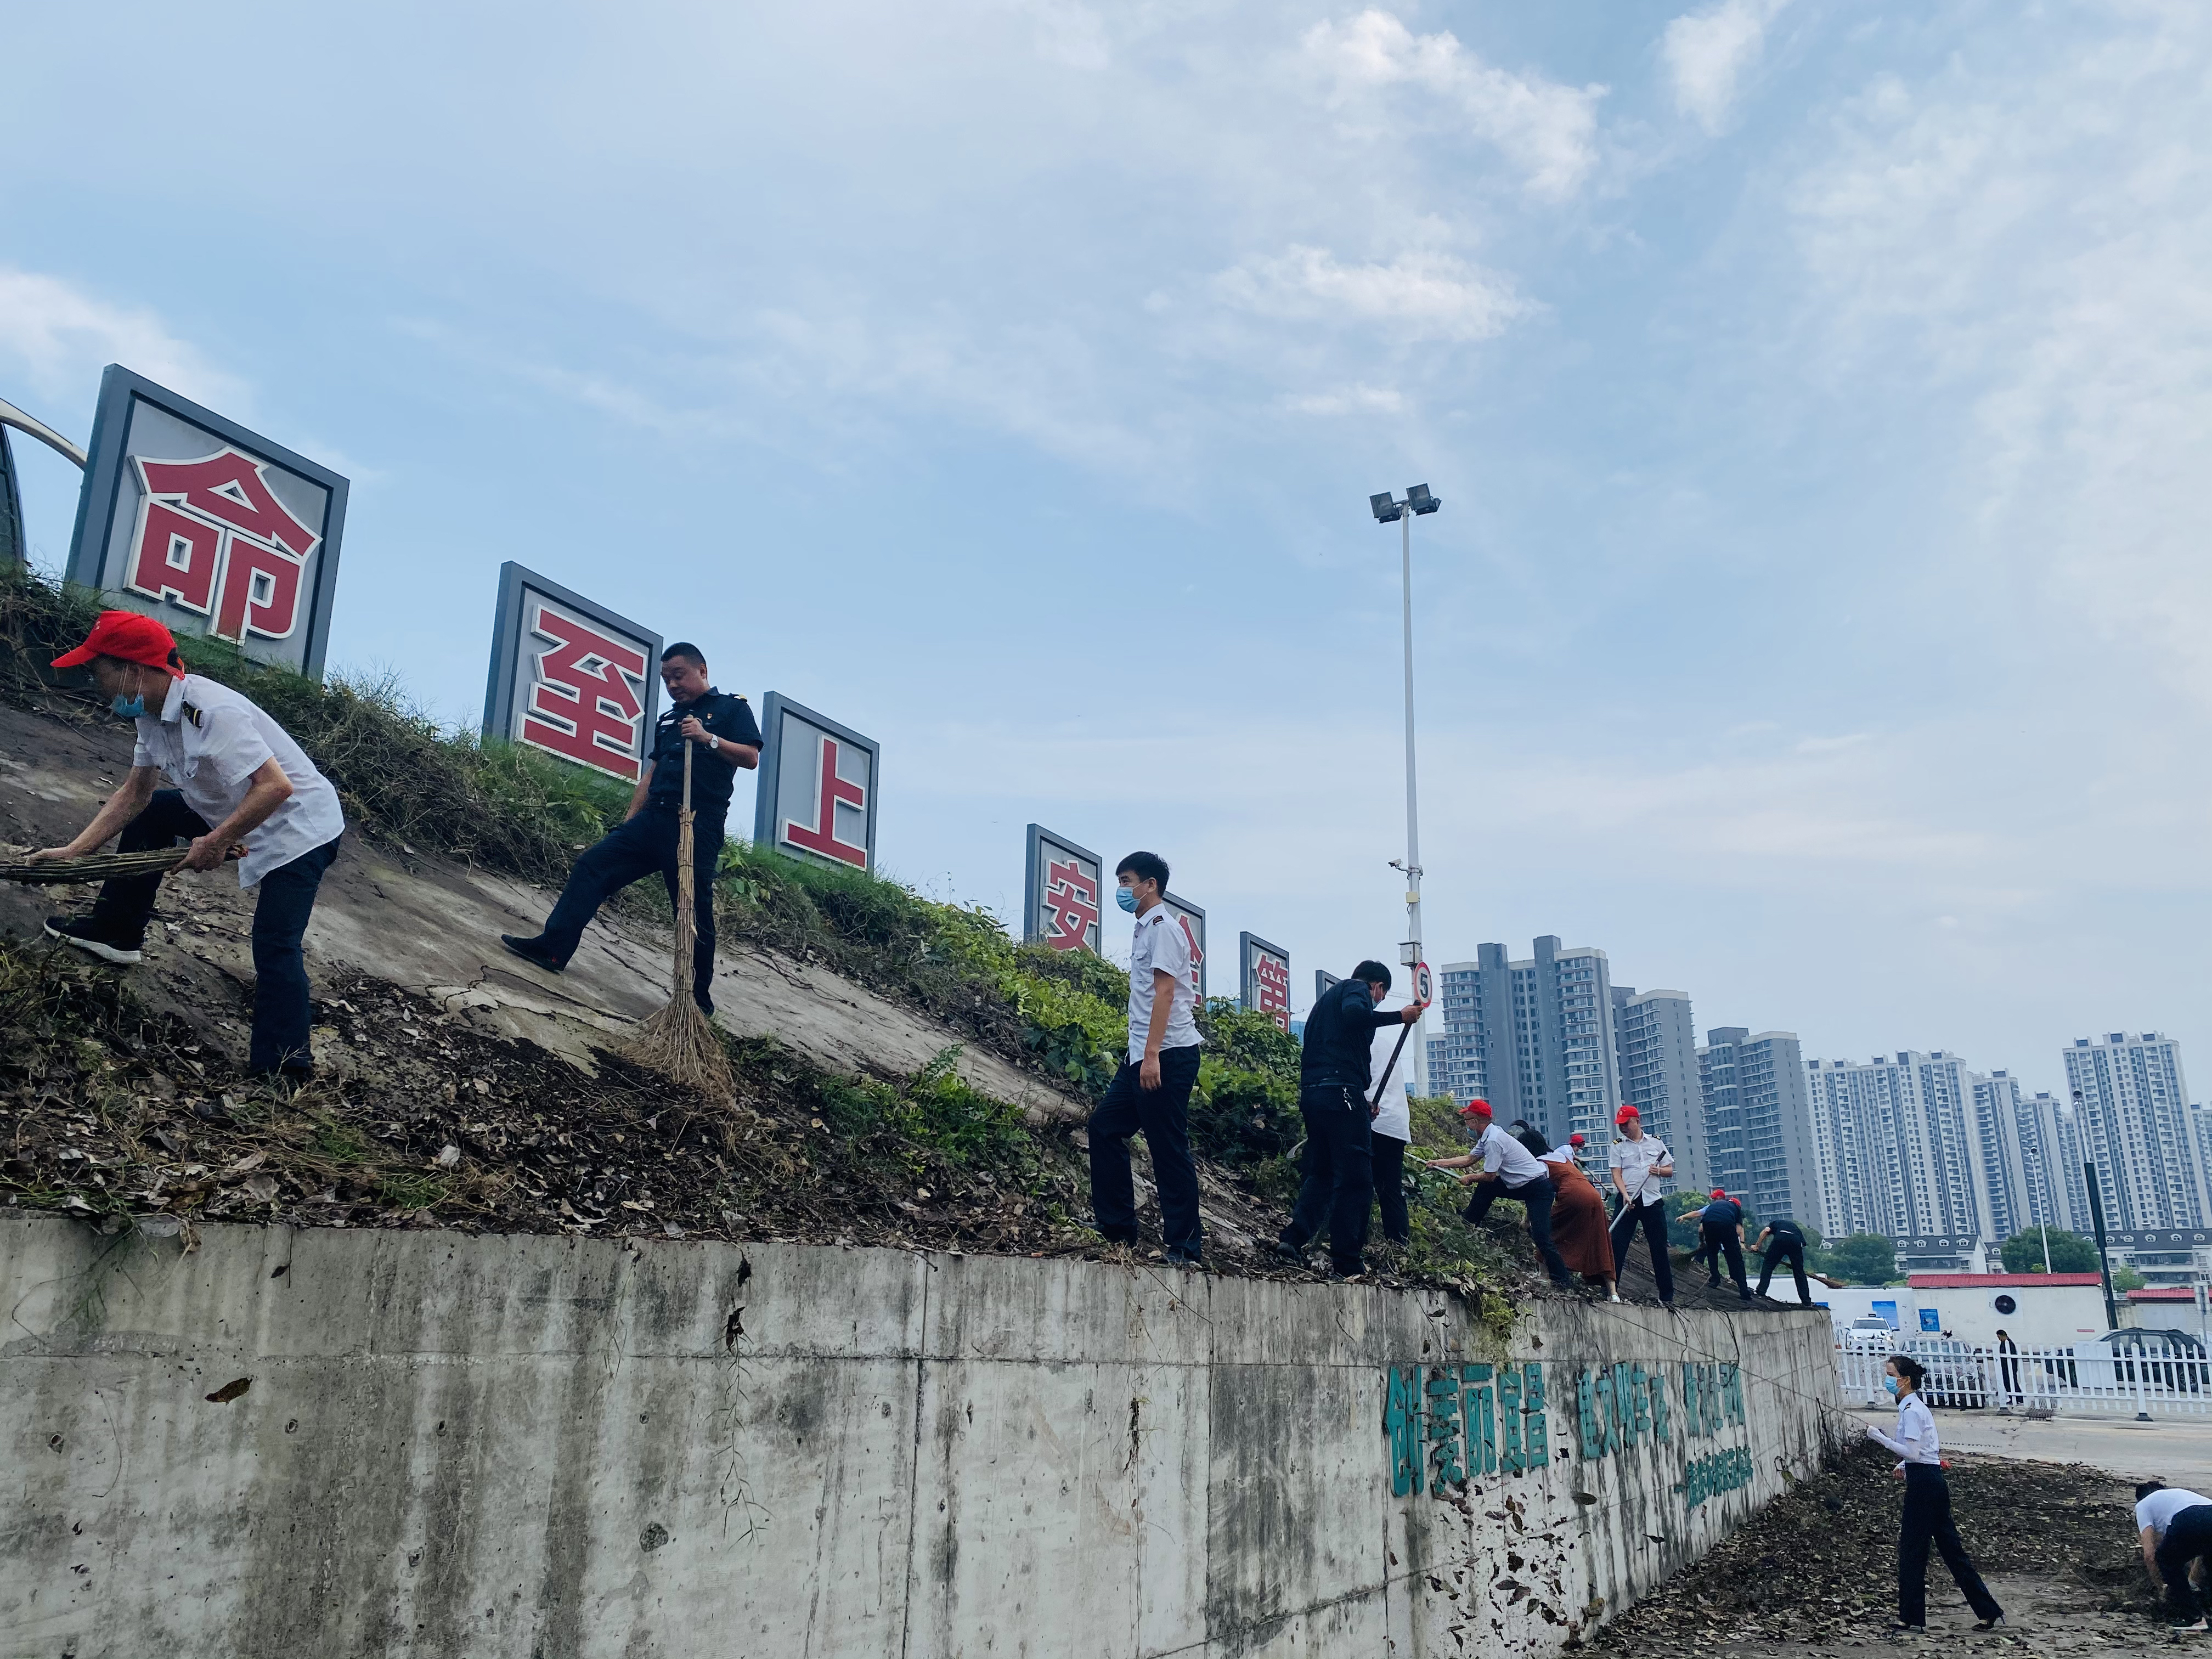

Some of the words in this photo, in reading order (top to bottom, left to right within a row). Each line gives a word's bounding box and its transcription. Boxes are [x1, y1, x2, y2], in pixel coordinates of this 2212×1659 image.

[125, 445, 323, 646] 命
[517, 603, 648, 786] 至
[780, 734, 867, 871] 上
[1042, 859, 1099, 952] 安
[1420, 973, 1428, 998] 5
